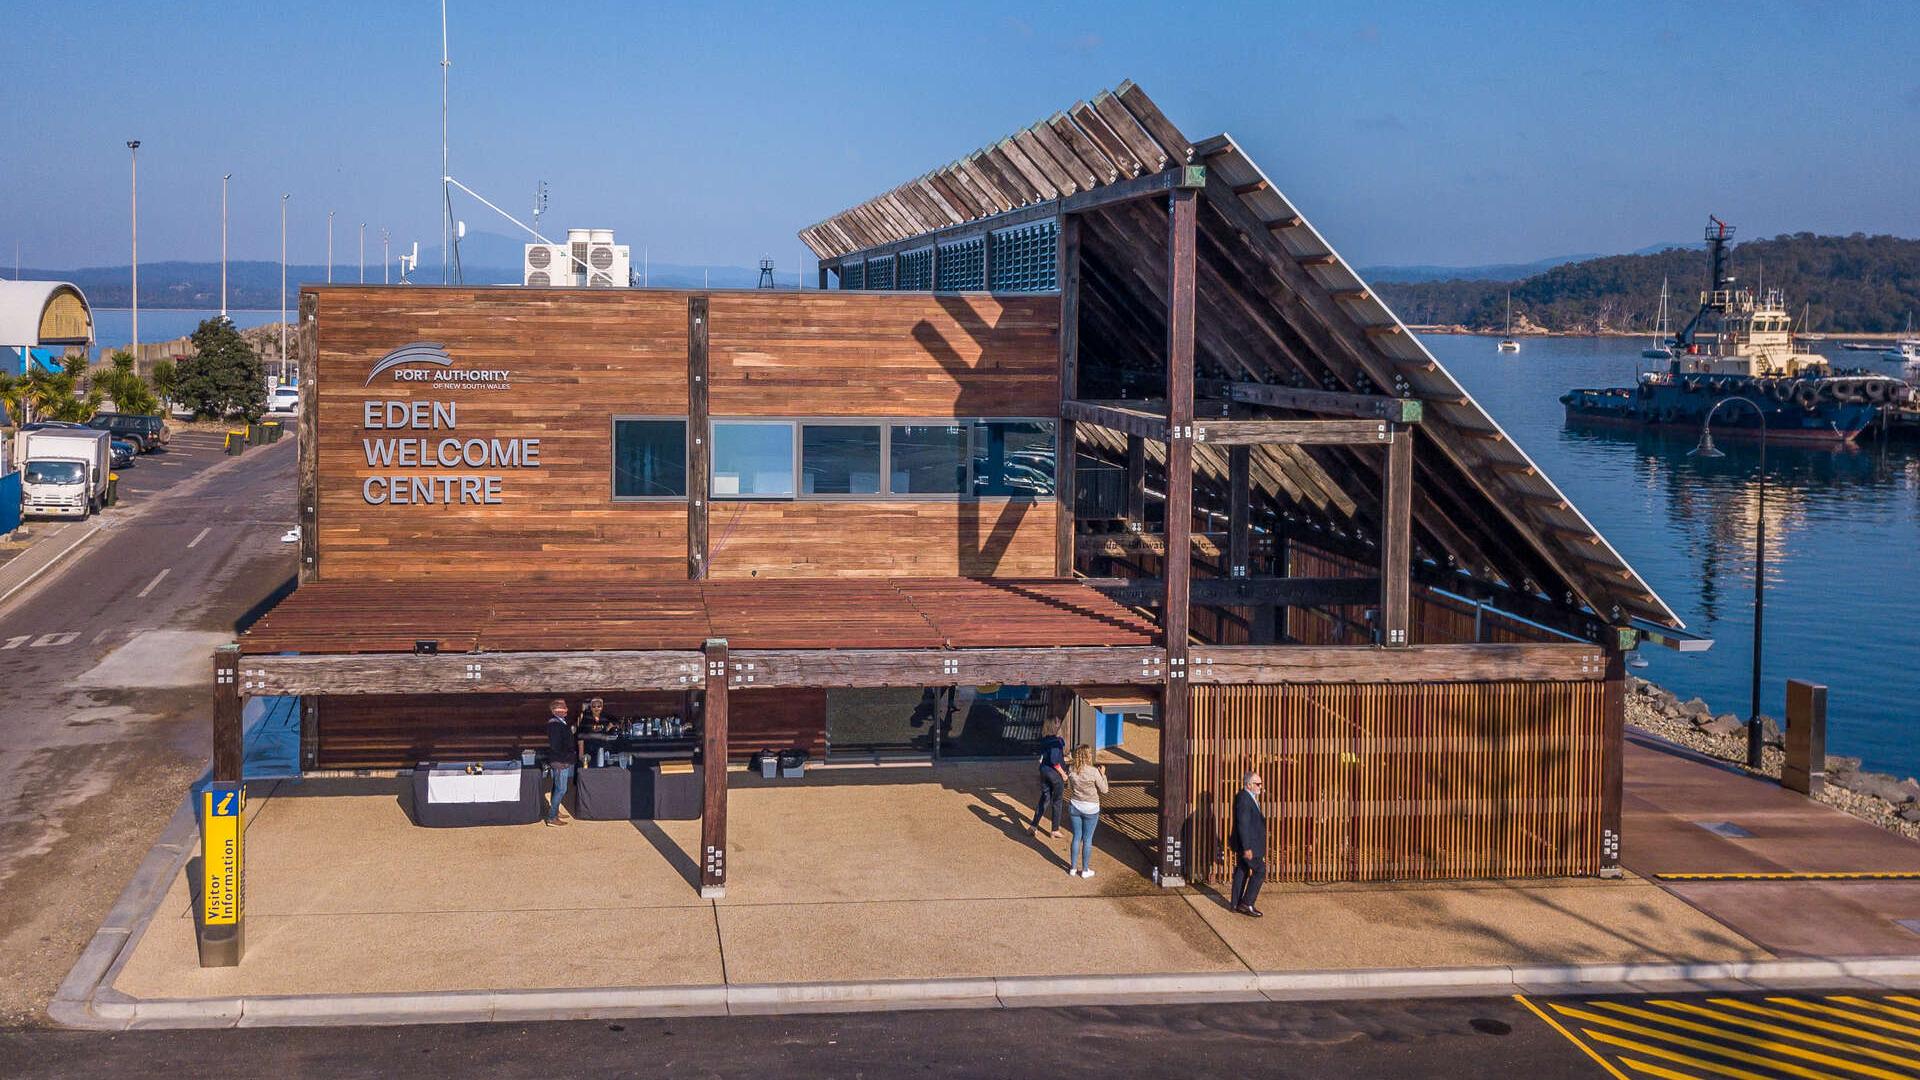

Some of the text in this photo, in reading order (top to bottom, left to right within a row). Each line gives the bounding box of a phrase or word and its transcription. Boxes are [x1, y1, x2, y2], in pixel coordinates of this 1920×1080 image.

[394, 370, 511, 381] PORT AUTHORITY
[363, 401, 457, 430] EDEN
[363, 438, 541, 468] WELCOME
[363, 475, 503, 505] CENTRE
[221, 838, 235, 920] Information
[207, 874, 221, 920] Visitor
